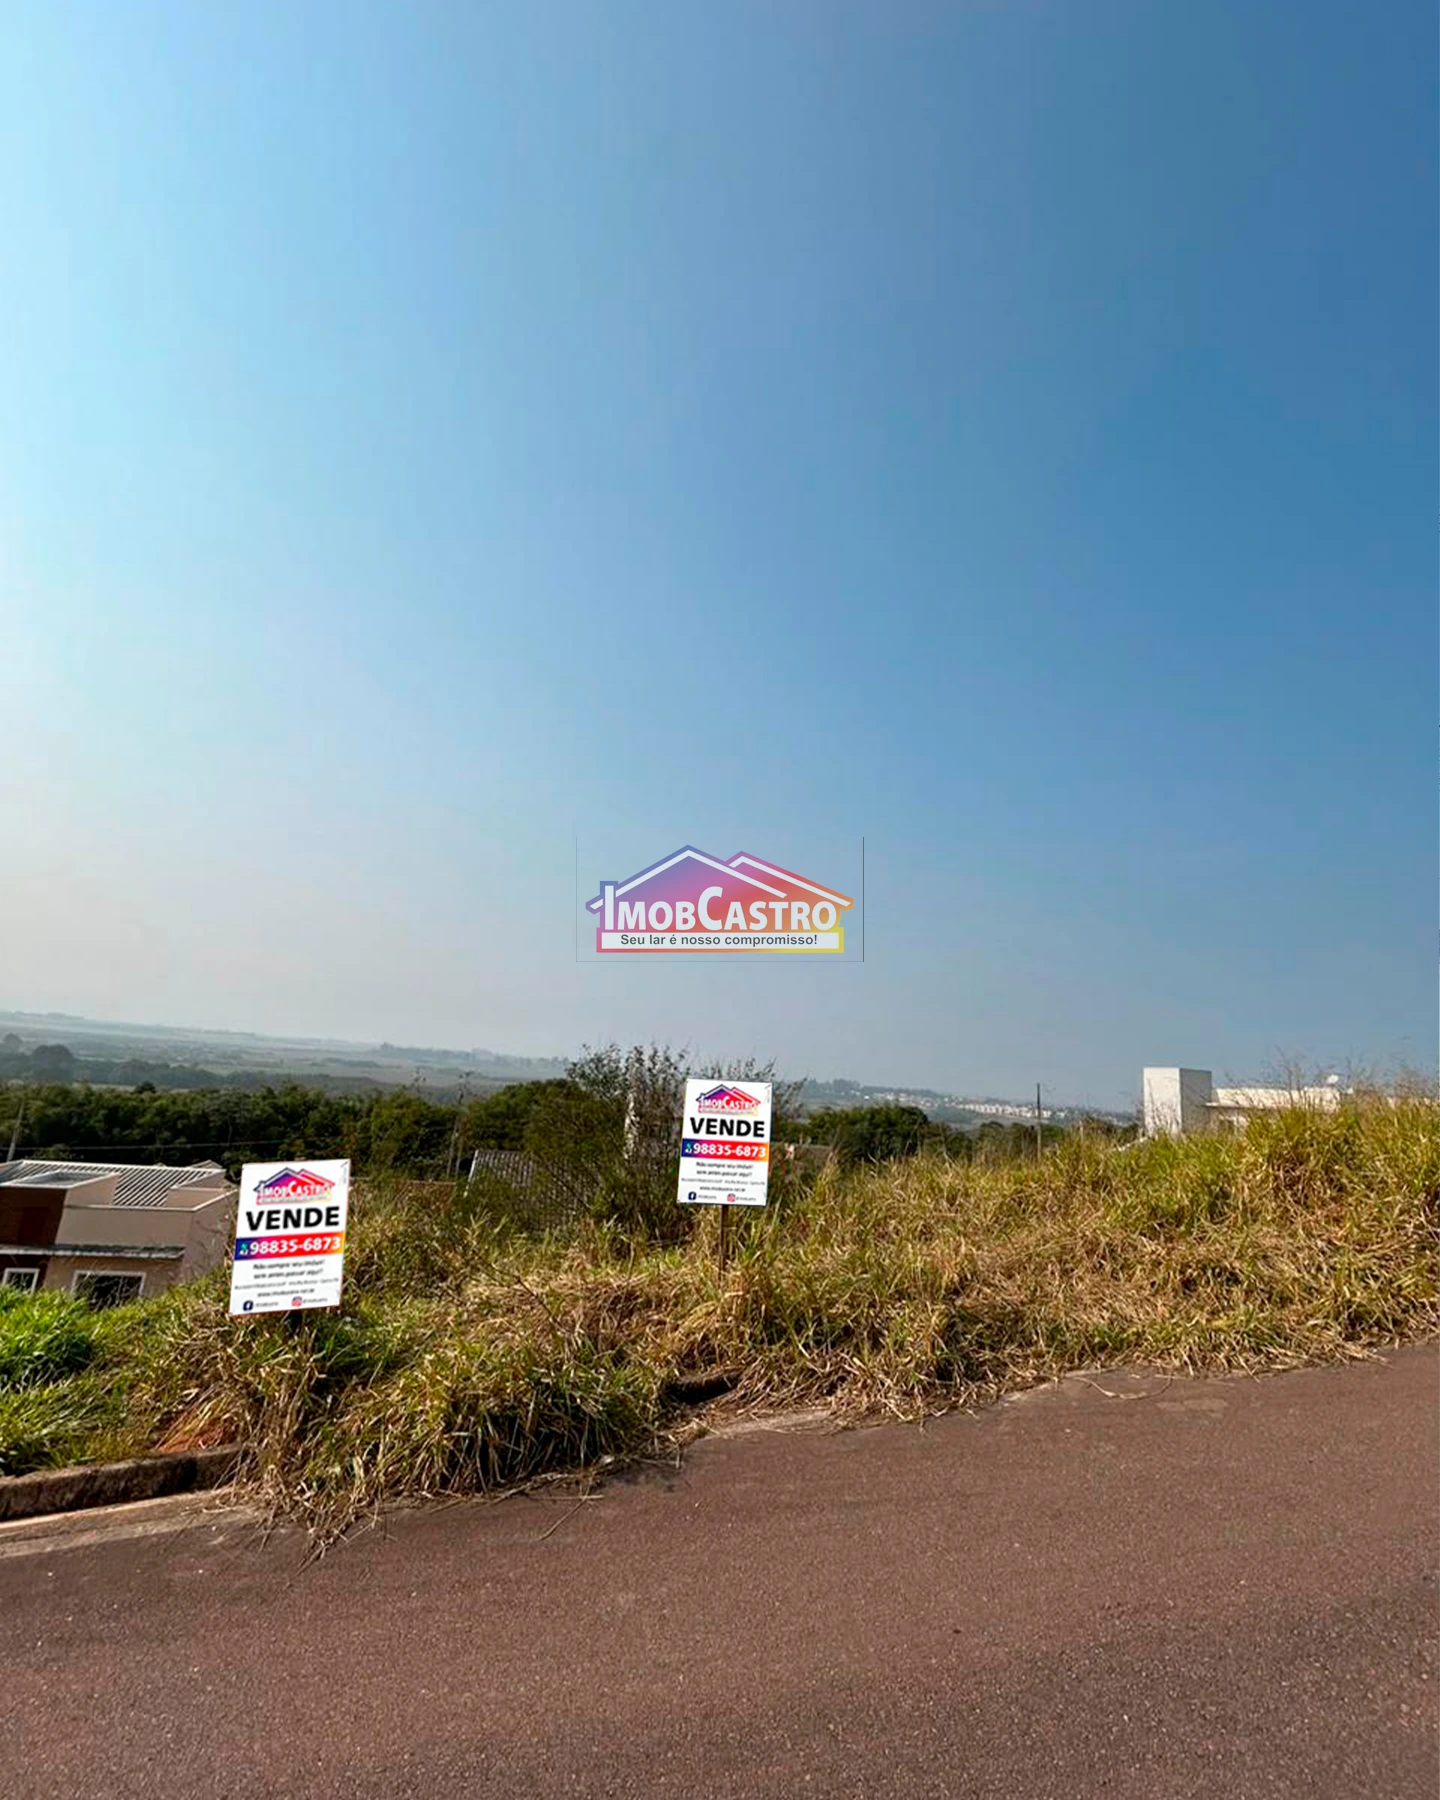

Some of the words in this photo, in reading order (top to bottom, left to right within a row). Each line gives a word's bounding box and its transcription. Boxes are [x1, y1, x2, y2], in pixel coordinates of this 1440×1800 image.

[690, 1117, 765, 1138] VENDE
[693, 1143, 766, 1158] 98835-6873
[246, 1206, 340, 1231] VENDE
[249, 1236, 341, 1255] 98835-6873
